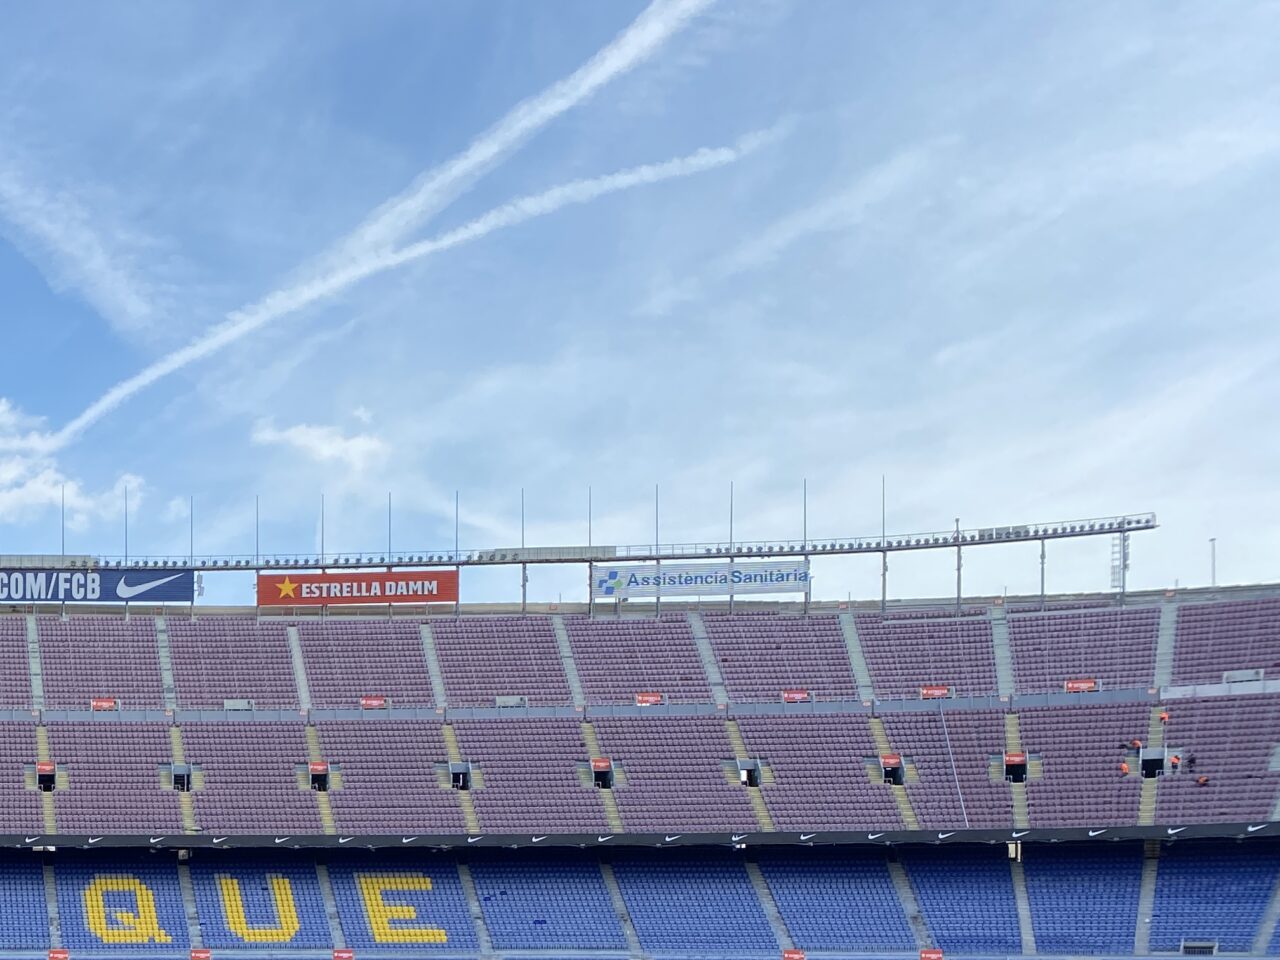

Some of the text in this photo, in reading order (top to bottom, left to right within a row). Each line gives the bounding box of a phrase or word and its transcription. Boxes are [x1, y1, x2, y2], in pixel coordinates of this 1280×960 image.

[627, 568, 809, 587] Assistència Sanitària
[301, 580, 438, 597] ESTRELLA DAMM
[83, 872, 448, 943] QUE
